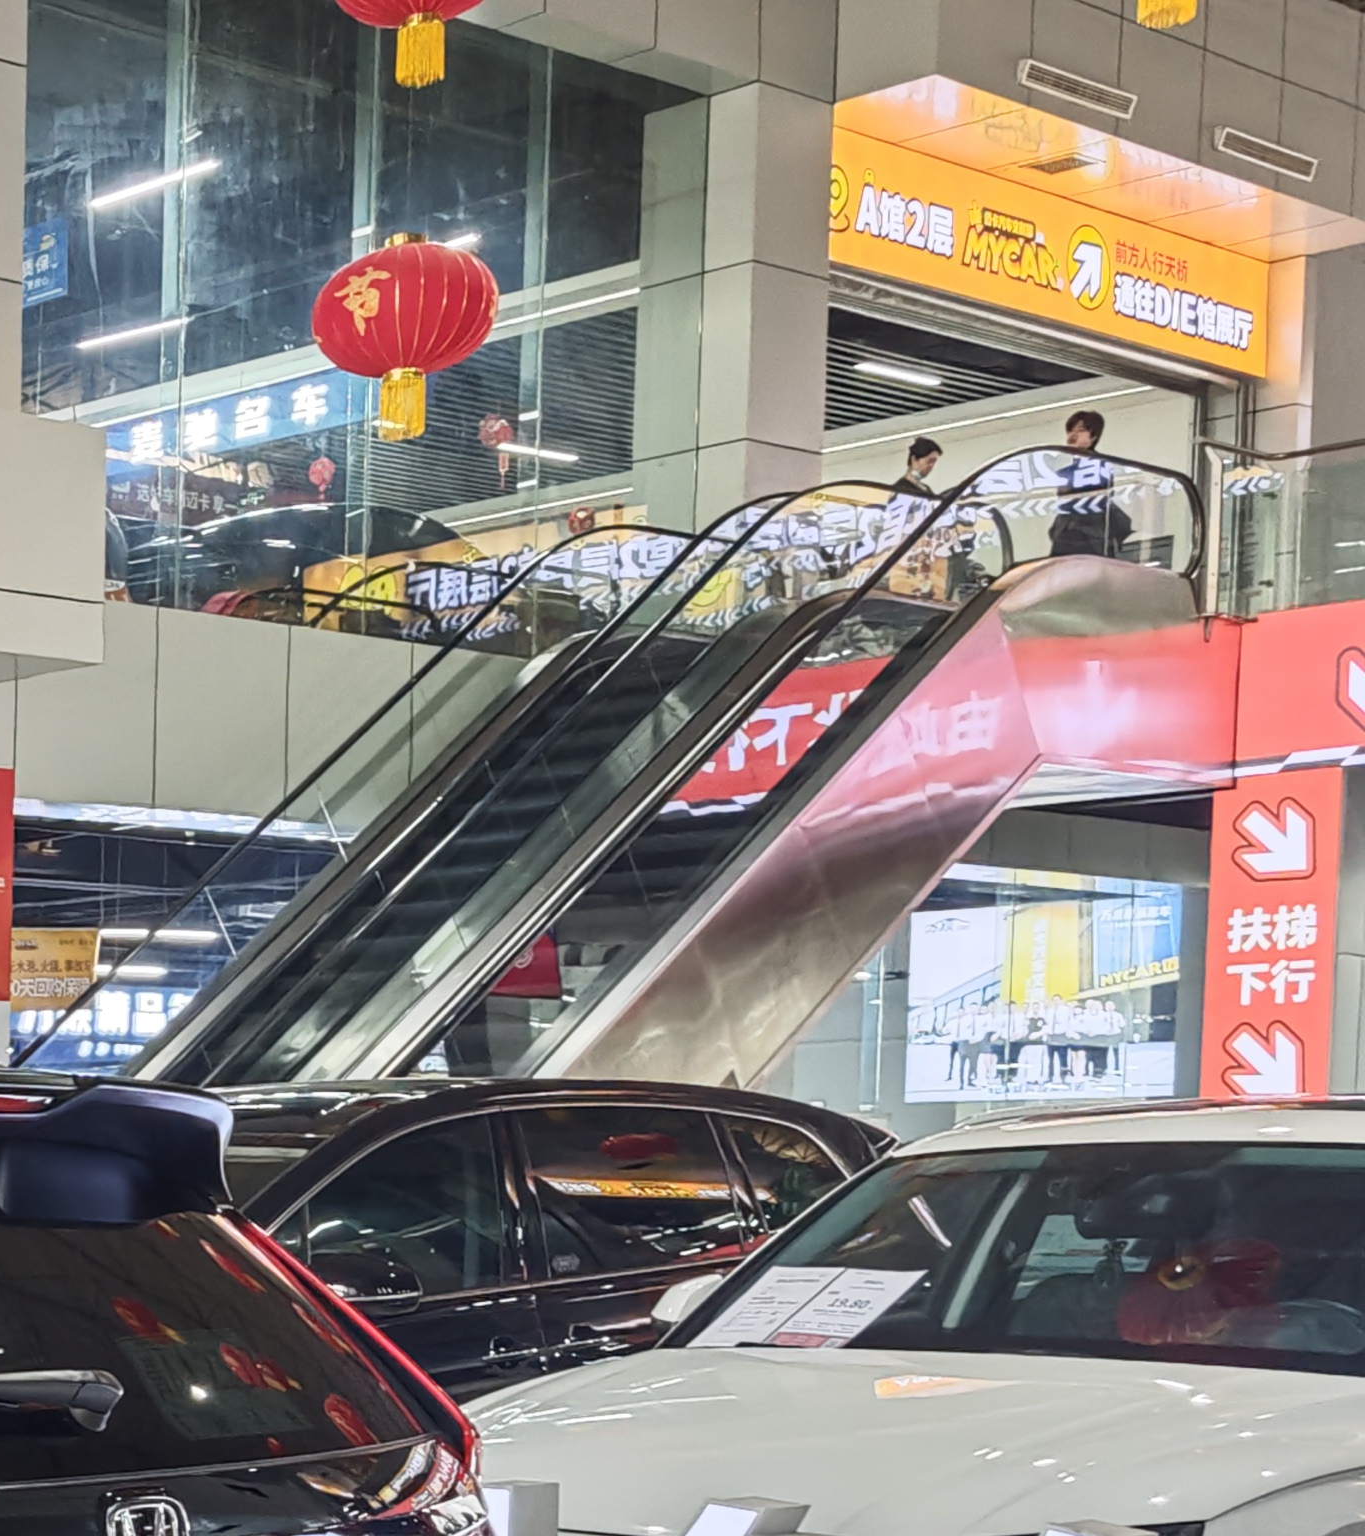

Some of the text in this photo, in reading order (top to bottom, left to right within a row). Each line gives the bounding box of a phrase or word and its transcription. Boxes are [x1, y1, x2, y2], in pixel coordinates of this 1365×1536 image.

[855, 183, 953, 260] A馆2层
[961, 226, 1062, 292] MYCAR
[1115, 241, 1188, 283] 前方人行天桥
[1227, 905, 1318, 954] 扶梯
[1226, 959, 1317, 1007] 下行
